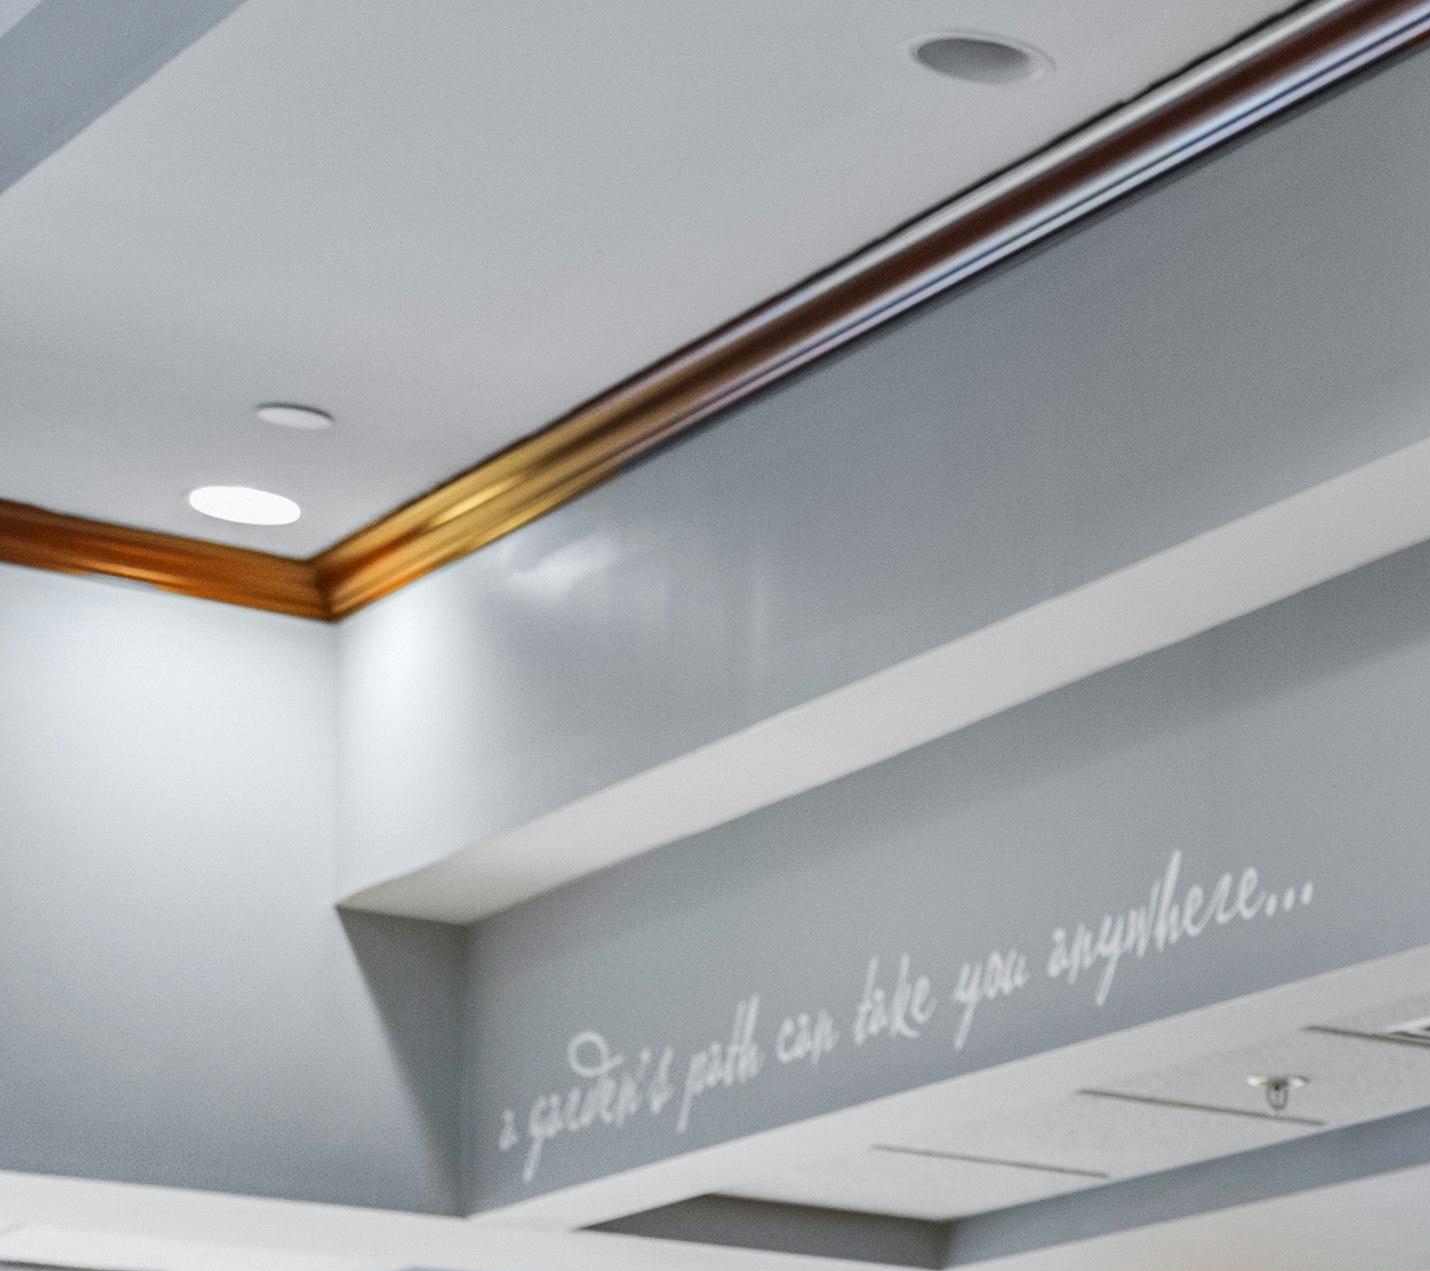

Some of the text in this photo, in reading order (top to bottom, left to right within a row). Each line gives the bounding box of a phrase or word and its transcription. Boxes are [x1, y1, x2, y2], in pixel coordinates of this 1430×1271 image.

[676, 995, 764, 1133] path
[775, 1004, 840, 1065] can
[852, 954, 937, 1045] take
[952, 944, 1032, 1052] you
